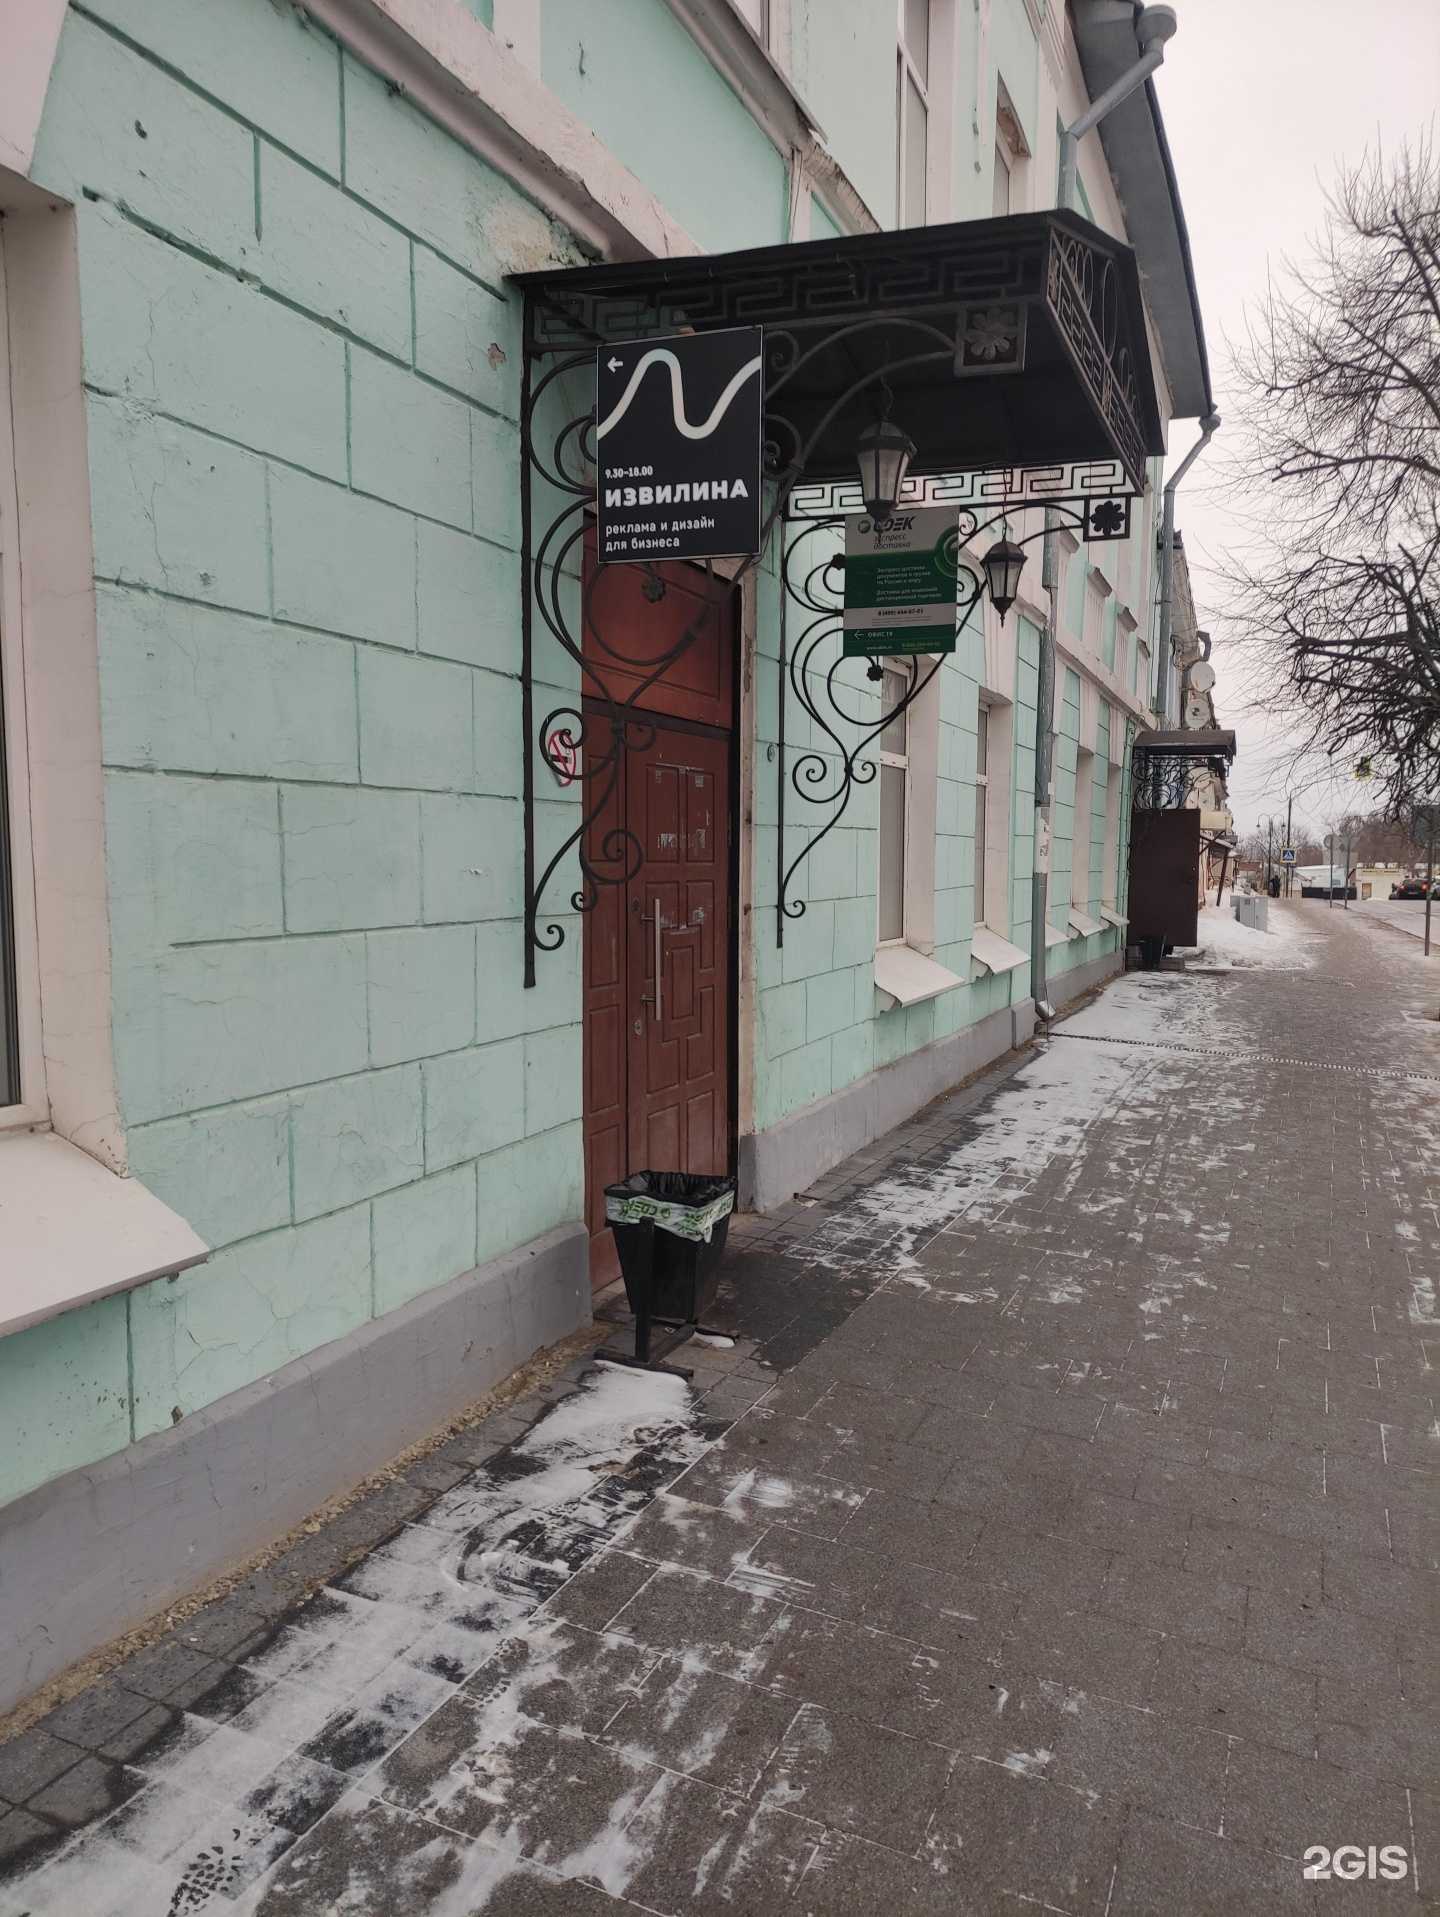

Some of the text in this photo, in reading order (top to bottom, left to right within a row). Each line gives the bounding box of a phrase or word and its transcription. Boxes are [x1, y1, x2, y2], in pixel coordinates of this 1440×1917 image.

[605, 479, 749, 508] ИЗВИЛИНА
[605, 516, 715, 537] реклама и дизайн
[605, 537, 680, 552] для бизнеса
